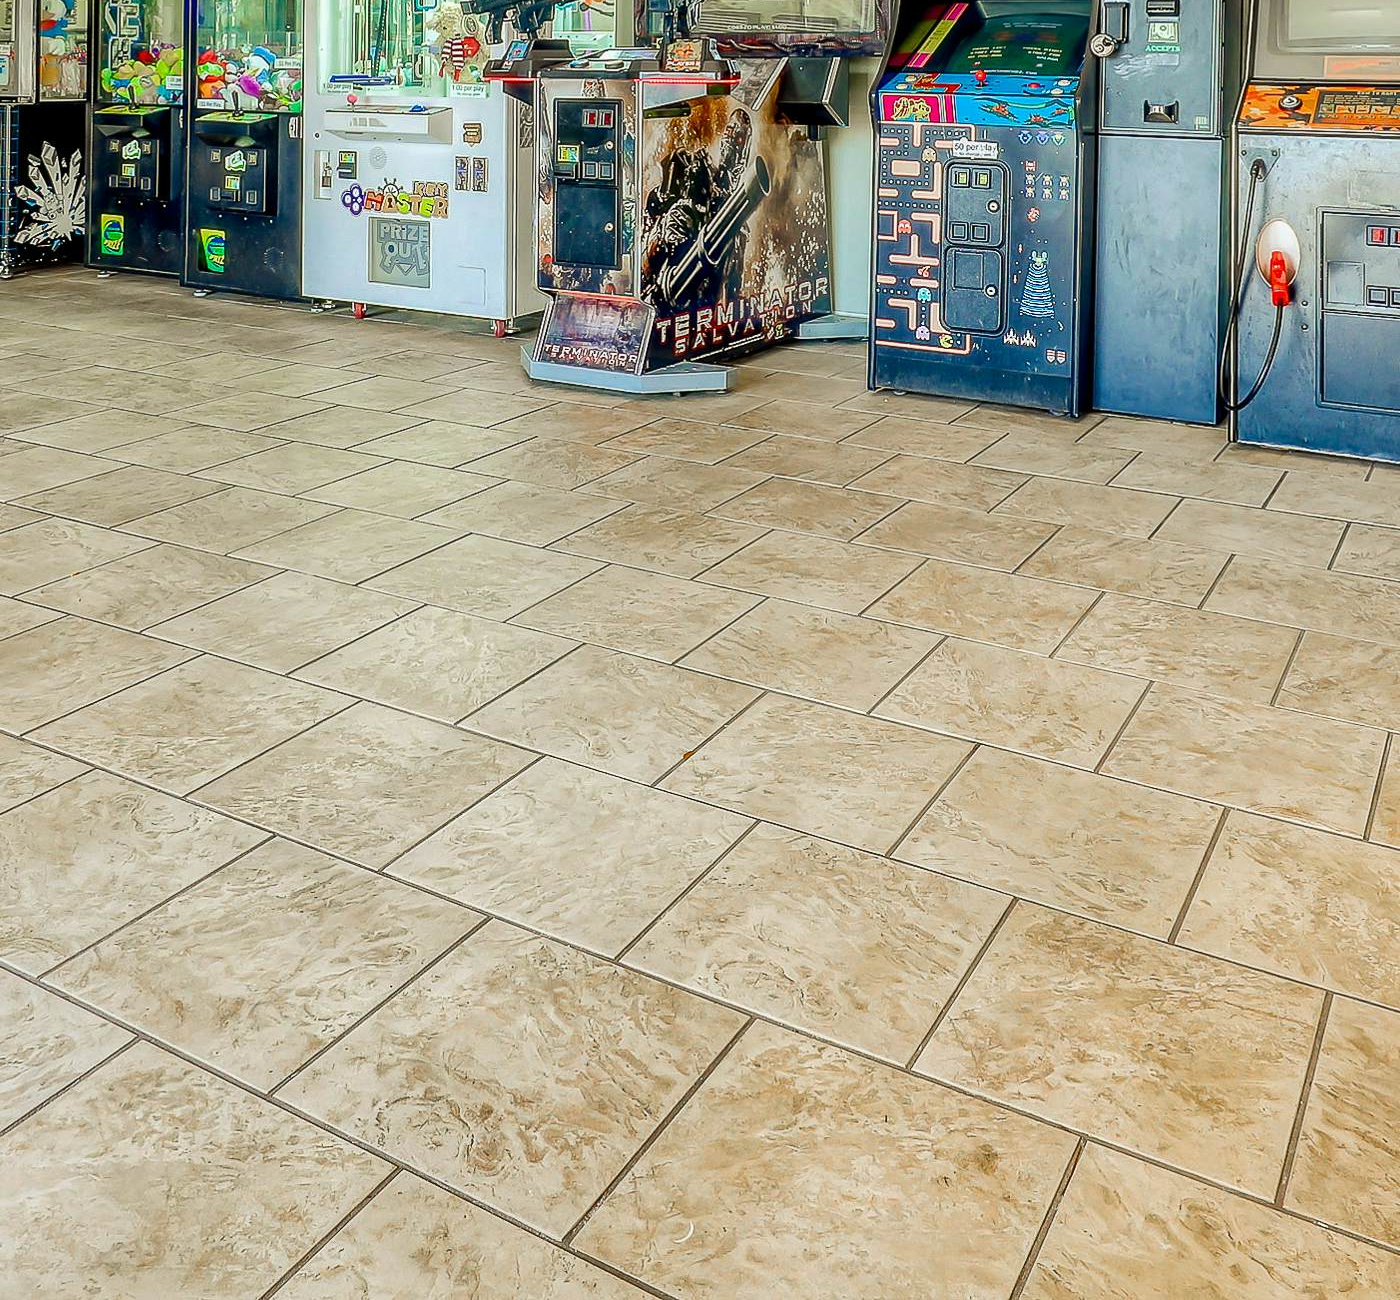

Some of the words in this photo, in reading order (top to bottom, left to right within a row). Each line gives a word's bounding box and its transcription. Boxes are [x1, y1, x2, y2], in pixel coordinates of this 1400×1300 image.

[413, 181, 449, 197] KEY
[364, 190, 449, 219] MASTER
[380, 222, 430, 243] PRIZE
[656, 277, 829, 343] TERMINATOR
[674, 300, 813, 354] SALVATION
[544, 344, 638, 363] TERMINATOR
[550, 352, 626, 367] SALVATION
